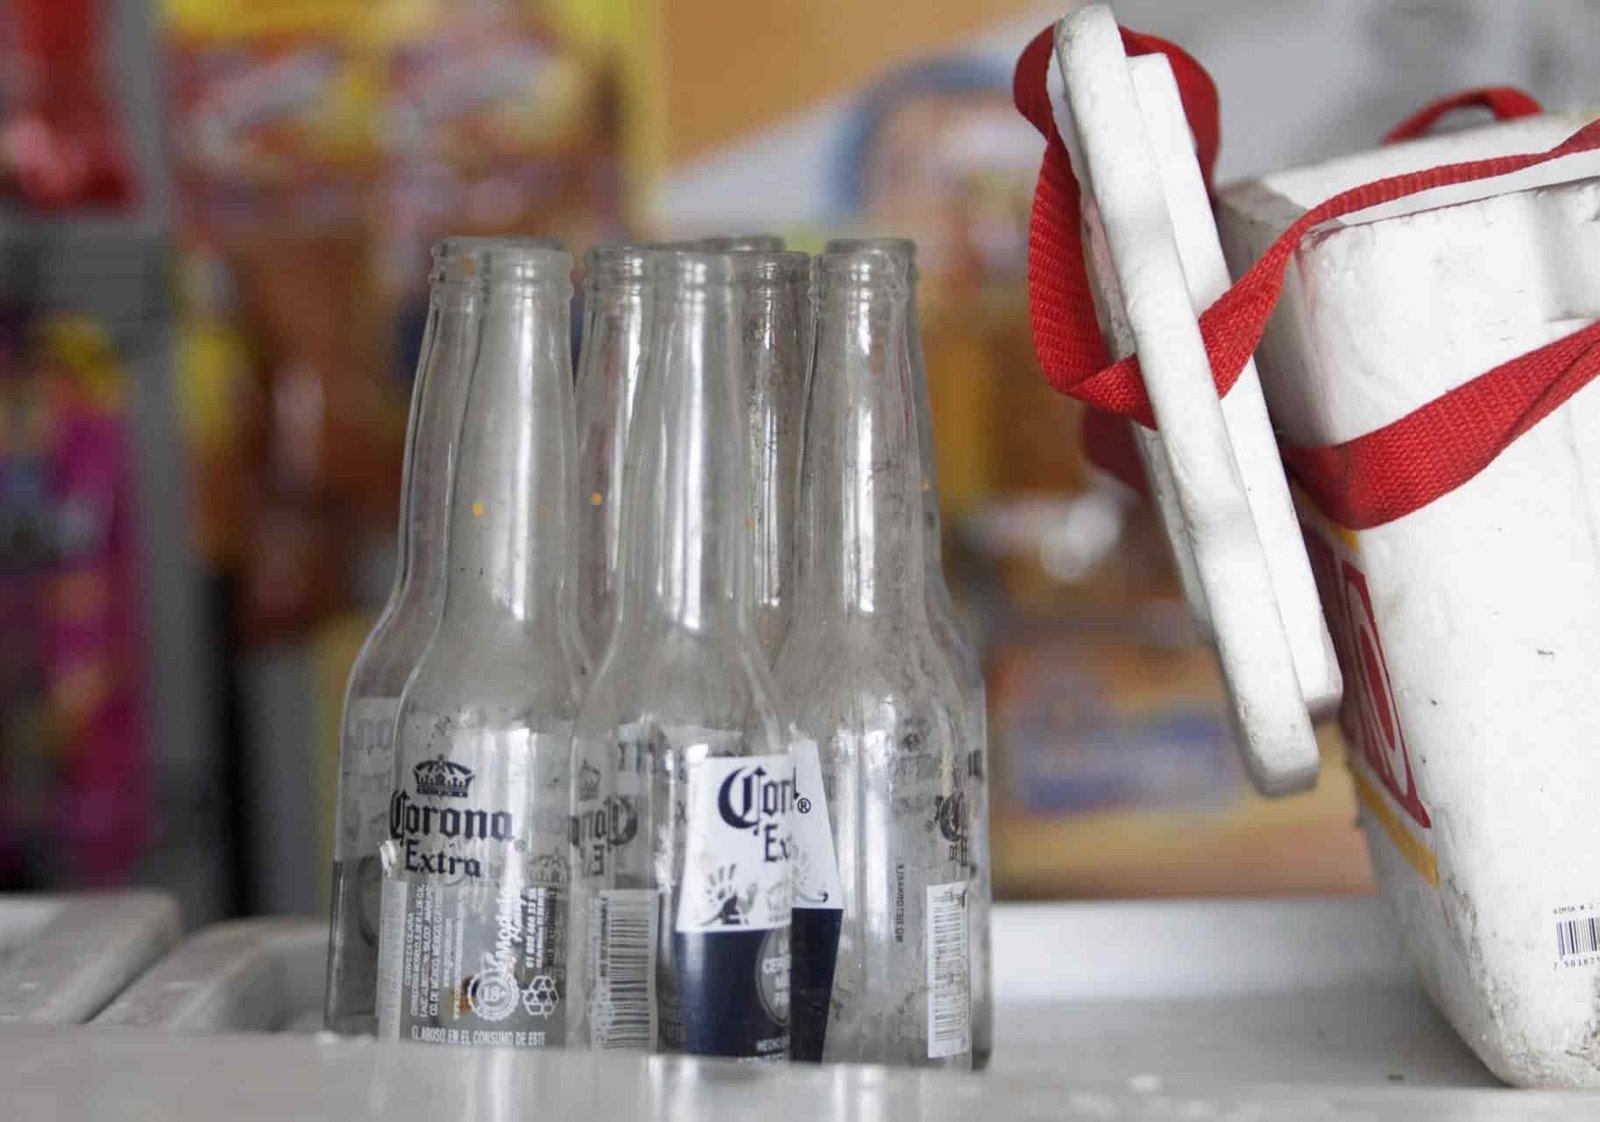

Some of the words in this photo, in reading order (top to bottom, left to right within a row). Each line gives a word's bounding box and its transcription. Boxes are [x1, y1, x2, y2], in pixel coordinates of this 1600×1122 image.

[390, 789, 515, 846] Corona
[405, 840, 481, 877] Extra
[472, 1030, 514, 1046] CONSUMO
